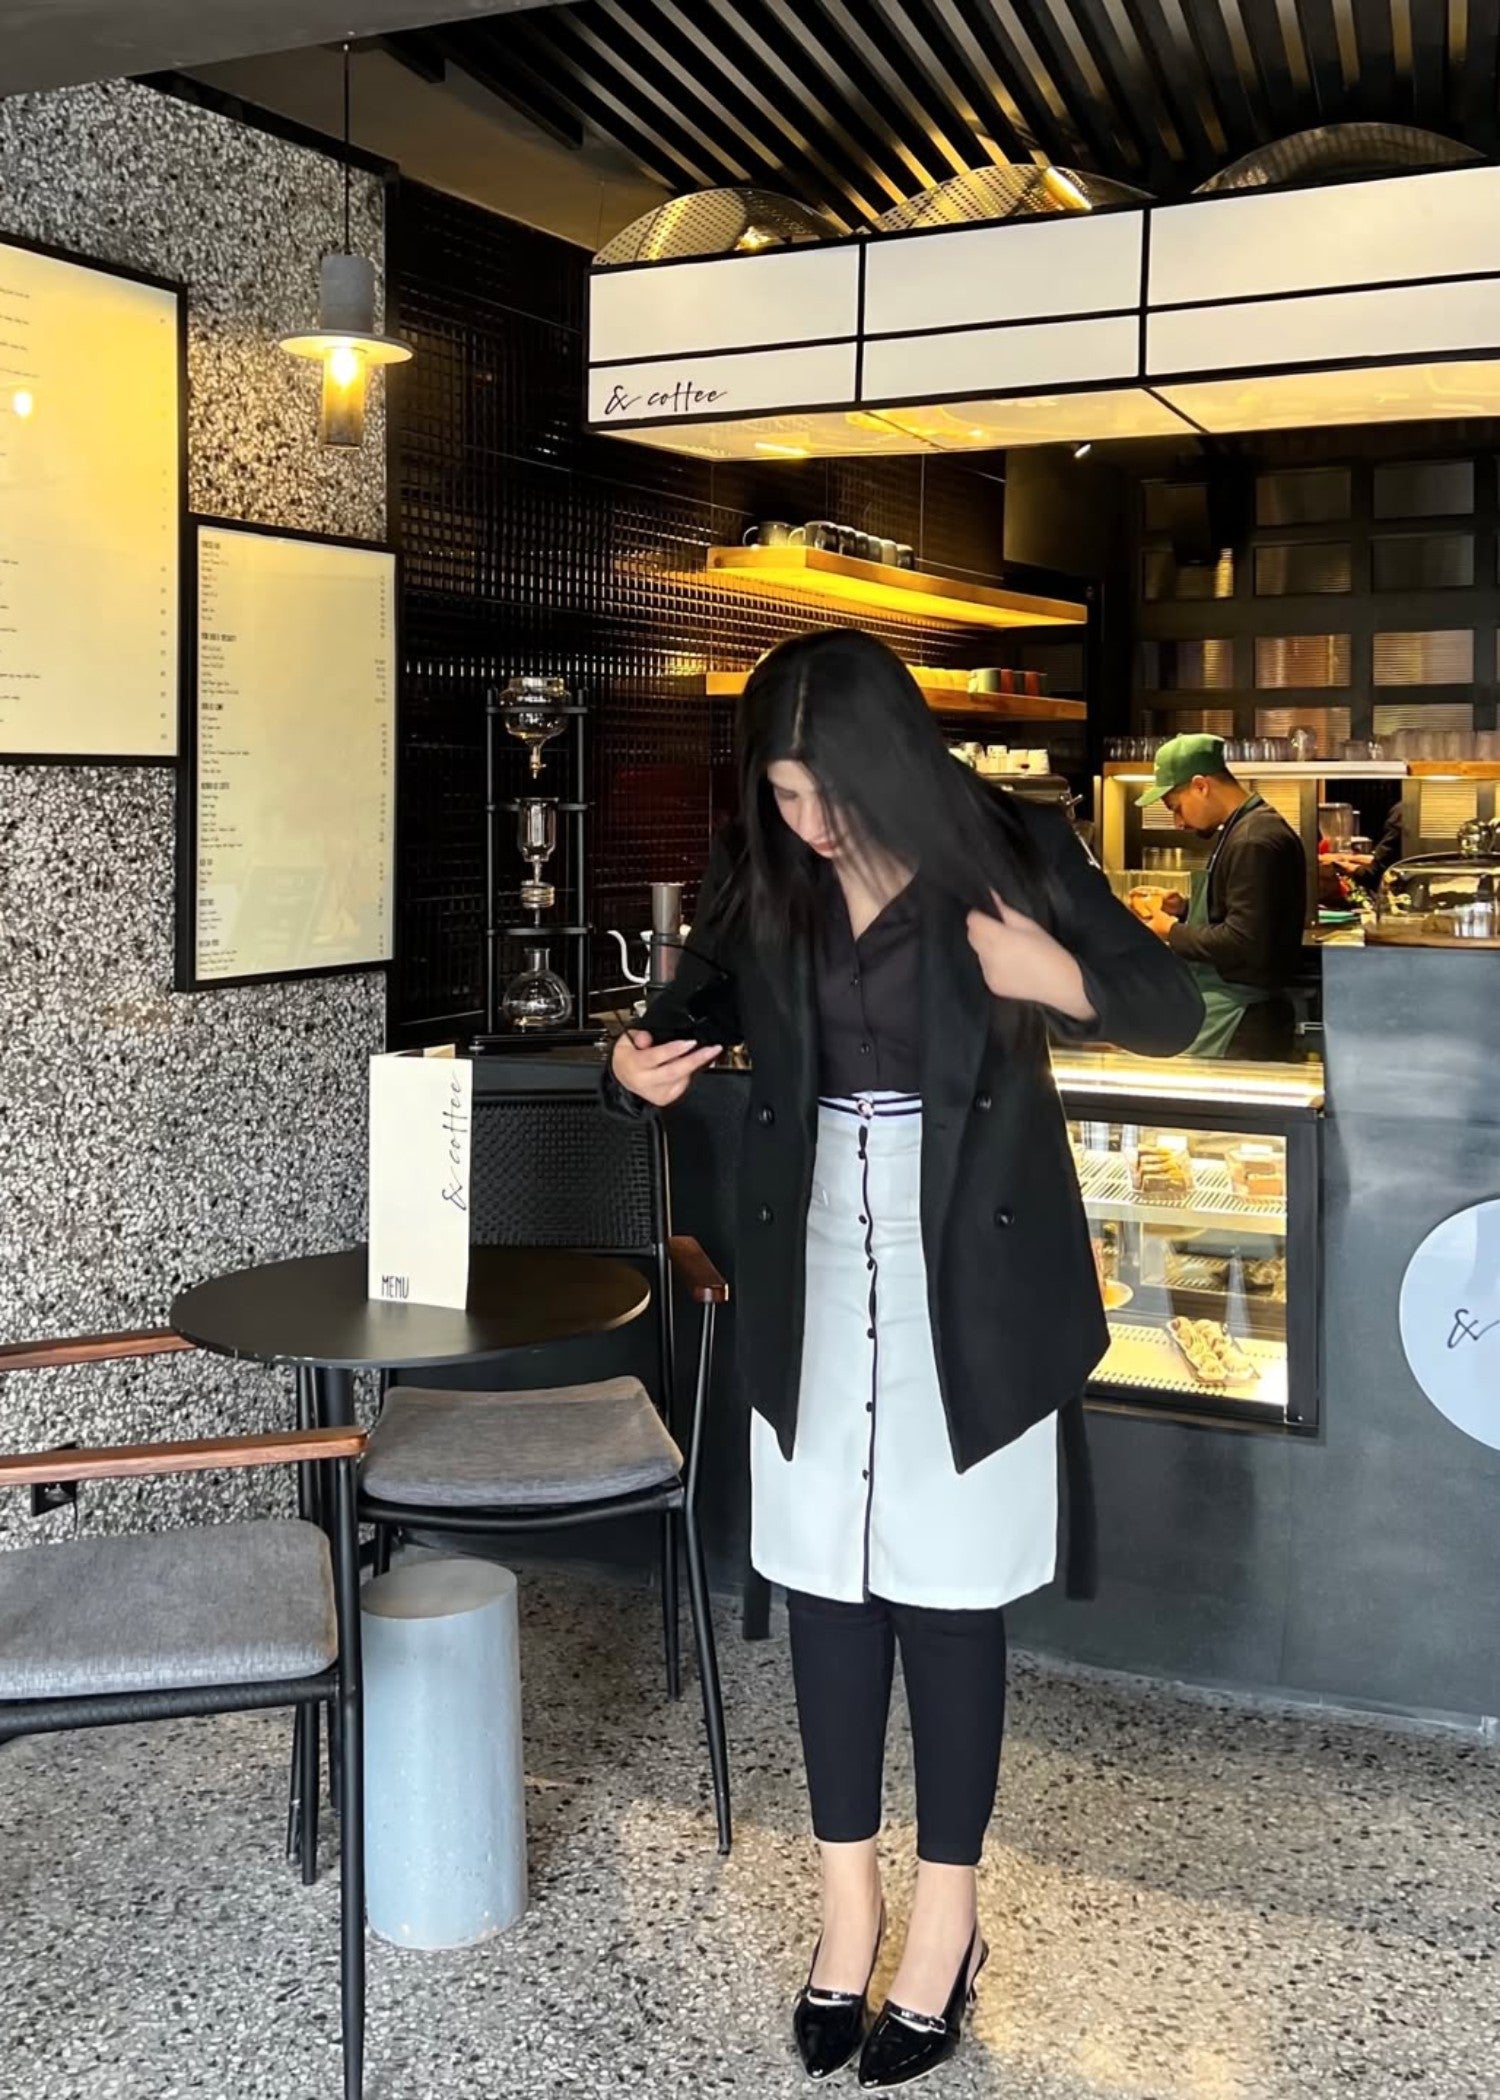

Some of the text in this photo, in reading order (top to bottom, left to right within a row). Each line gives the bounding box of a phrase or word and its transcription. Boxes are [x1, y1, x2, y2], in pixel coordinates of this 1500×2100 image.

[604, 381, 727, 415] & coffee
[441, 1071, 468, 1211] & coffee
[381, 1274, 410, 1299] MENU
[1447, 1308, 1500, 1349] &
